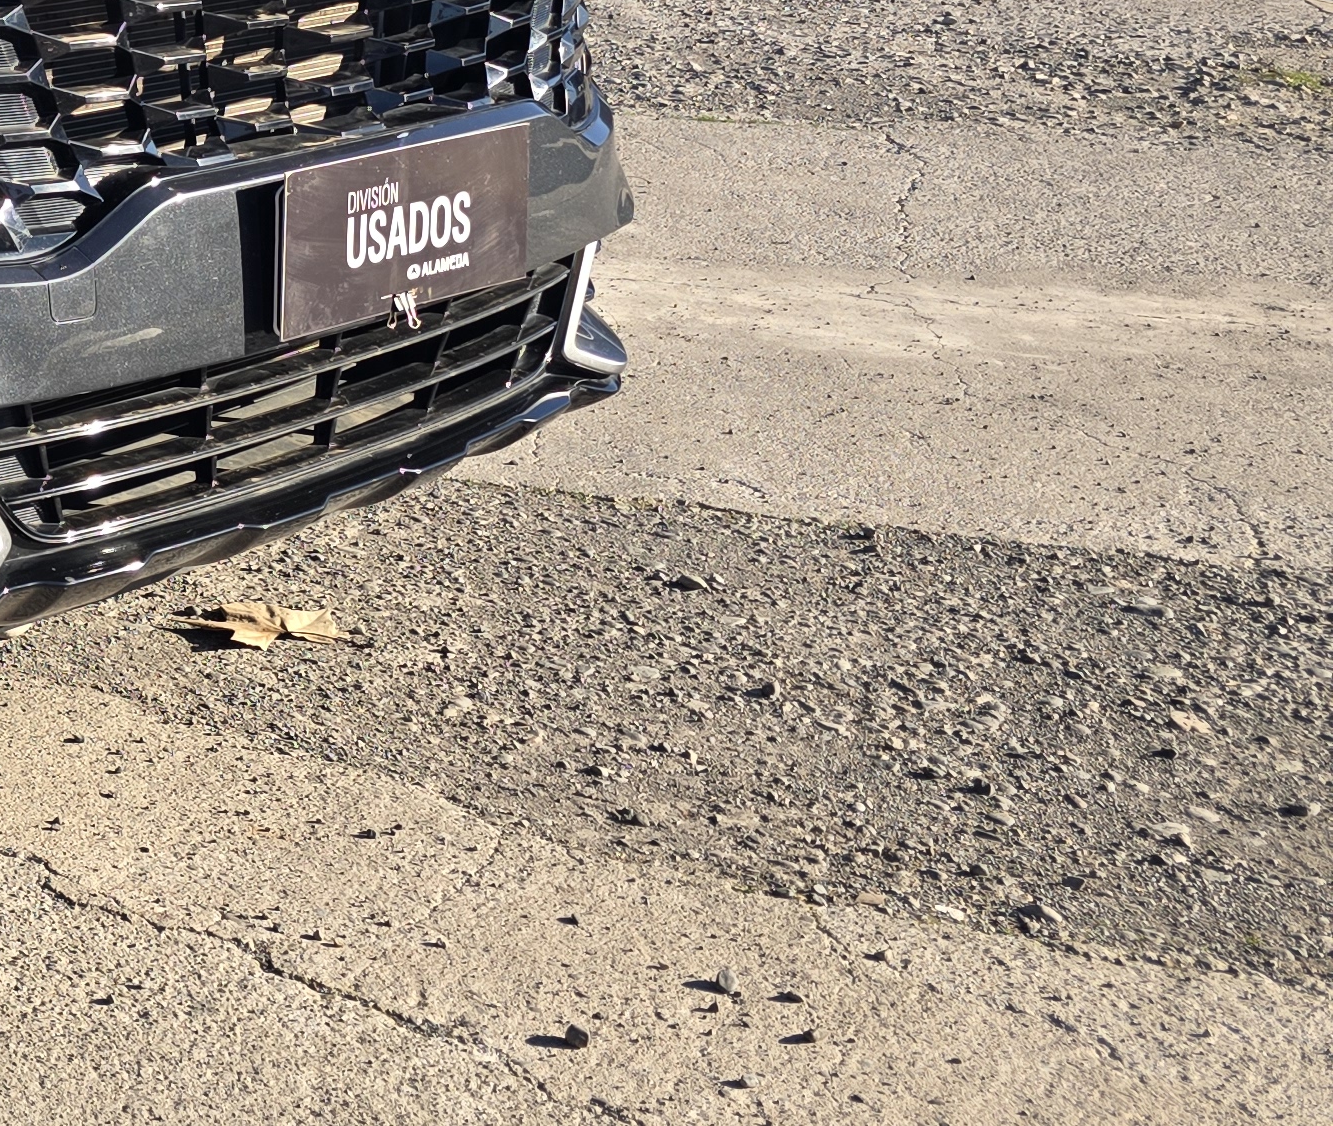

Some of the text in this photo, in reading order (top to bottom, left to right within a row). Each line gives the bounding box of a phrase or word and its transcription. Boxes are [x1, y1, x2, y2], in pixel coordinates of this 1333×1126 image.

[348, 178, 399, 214] DIVISIÓN
[346, 191, 471, 269] USADOS
[421, 252, 469, 277] ALAMEDA
